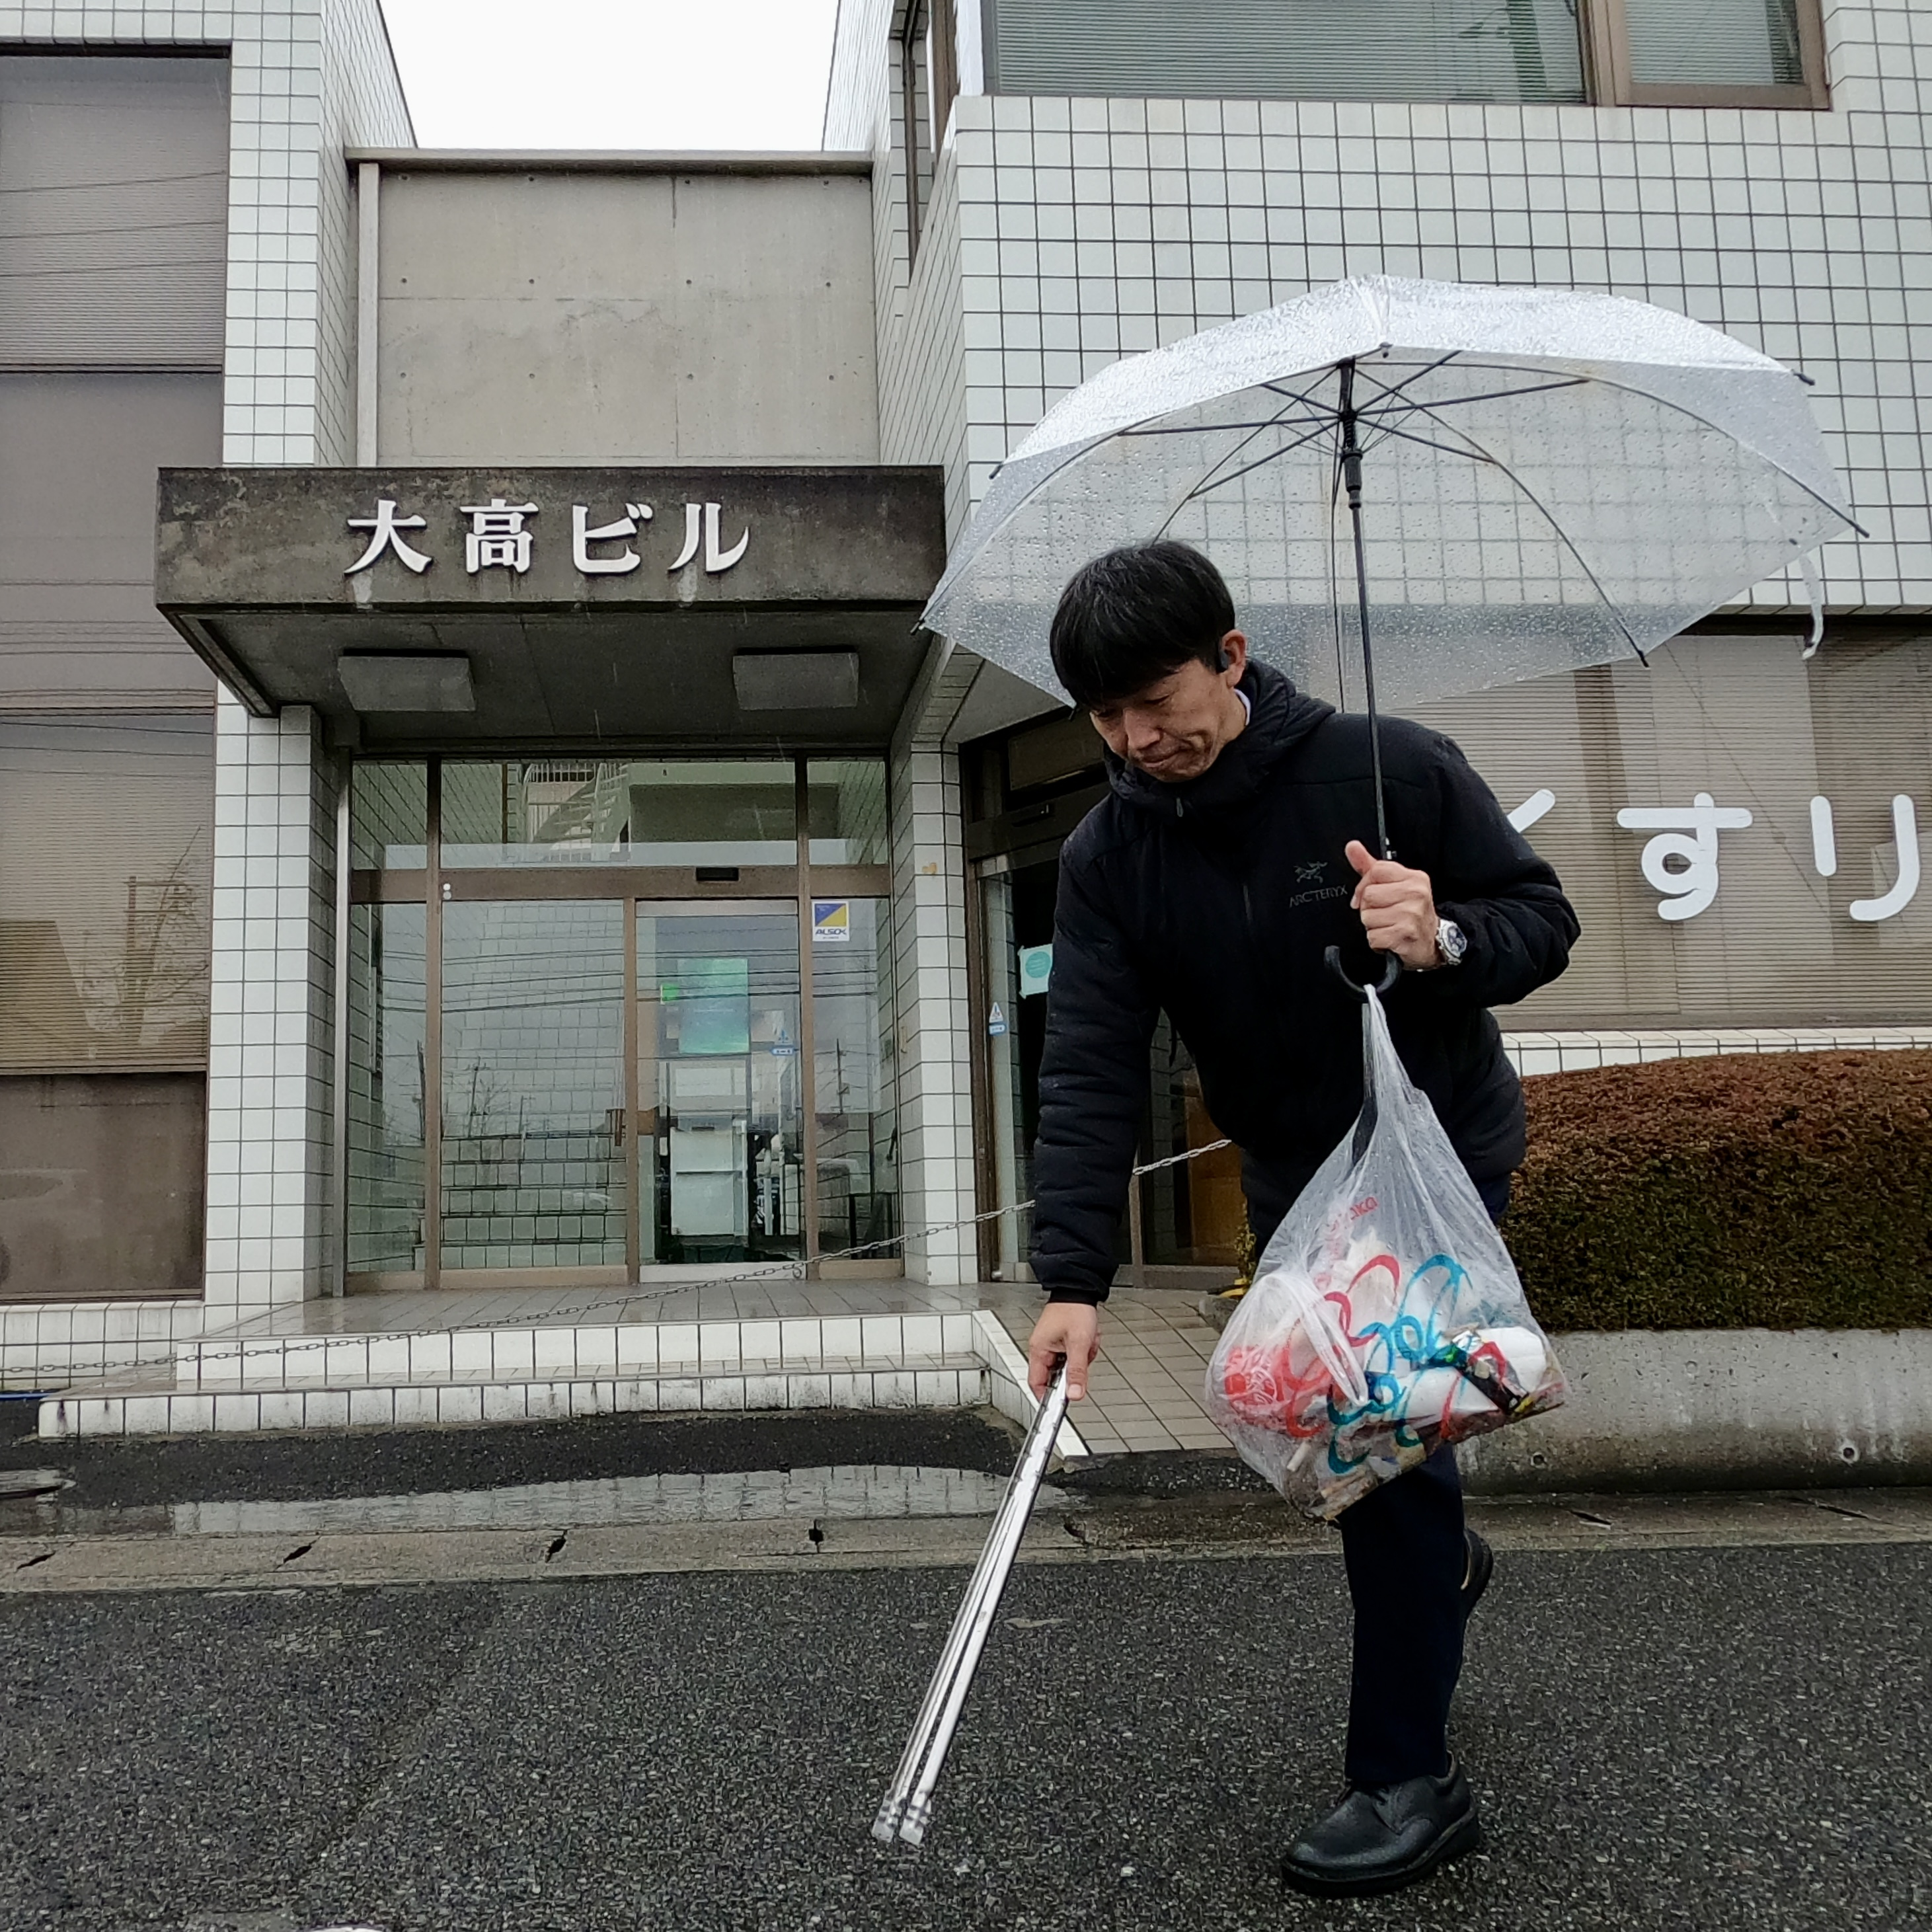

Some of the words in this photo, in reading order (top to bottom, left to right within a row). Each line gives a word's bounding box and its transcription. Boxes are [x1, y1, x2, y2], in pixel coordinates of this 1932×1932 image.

[344, 498, 749, 574] 大高ビル
[1507, 789, 1921, 921] すり
